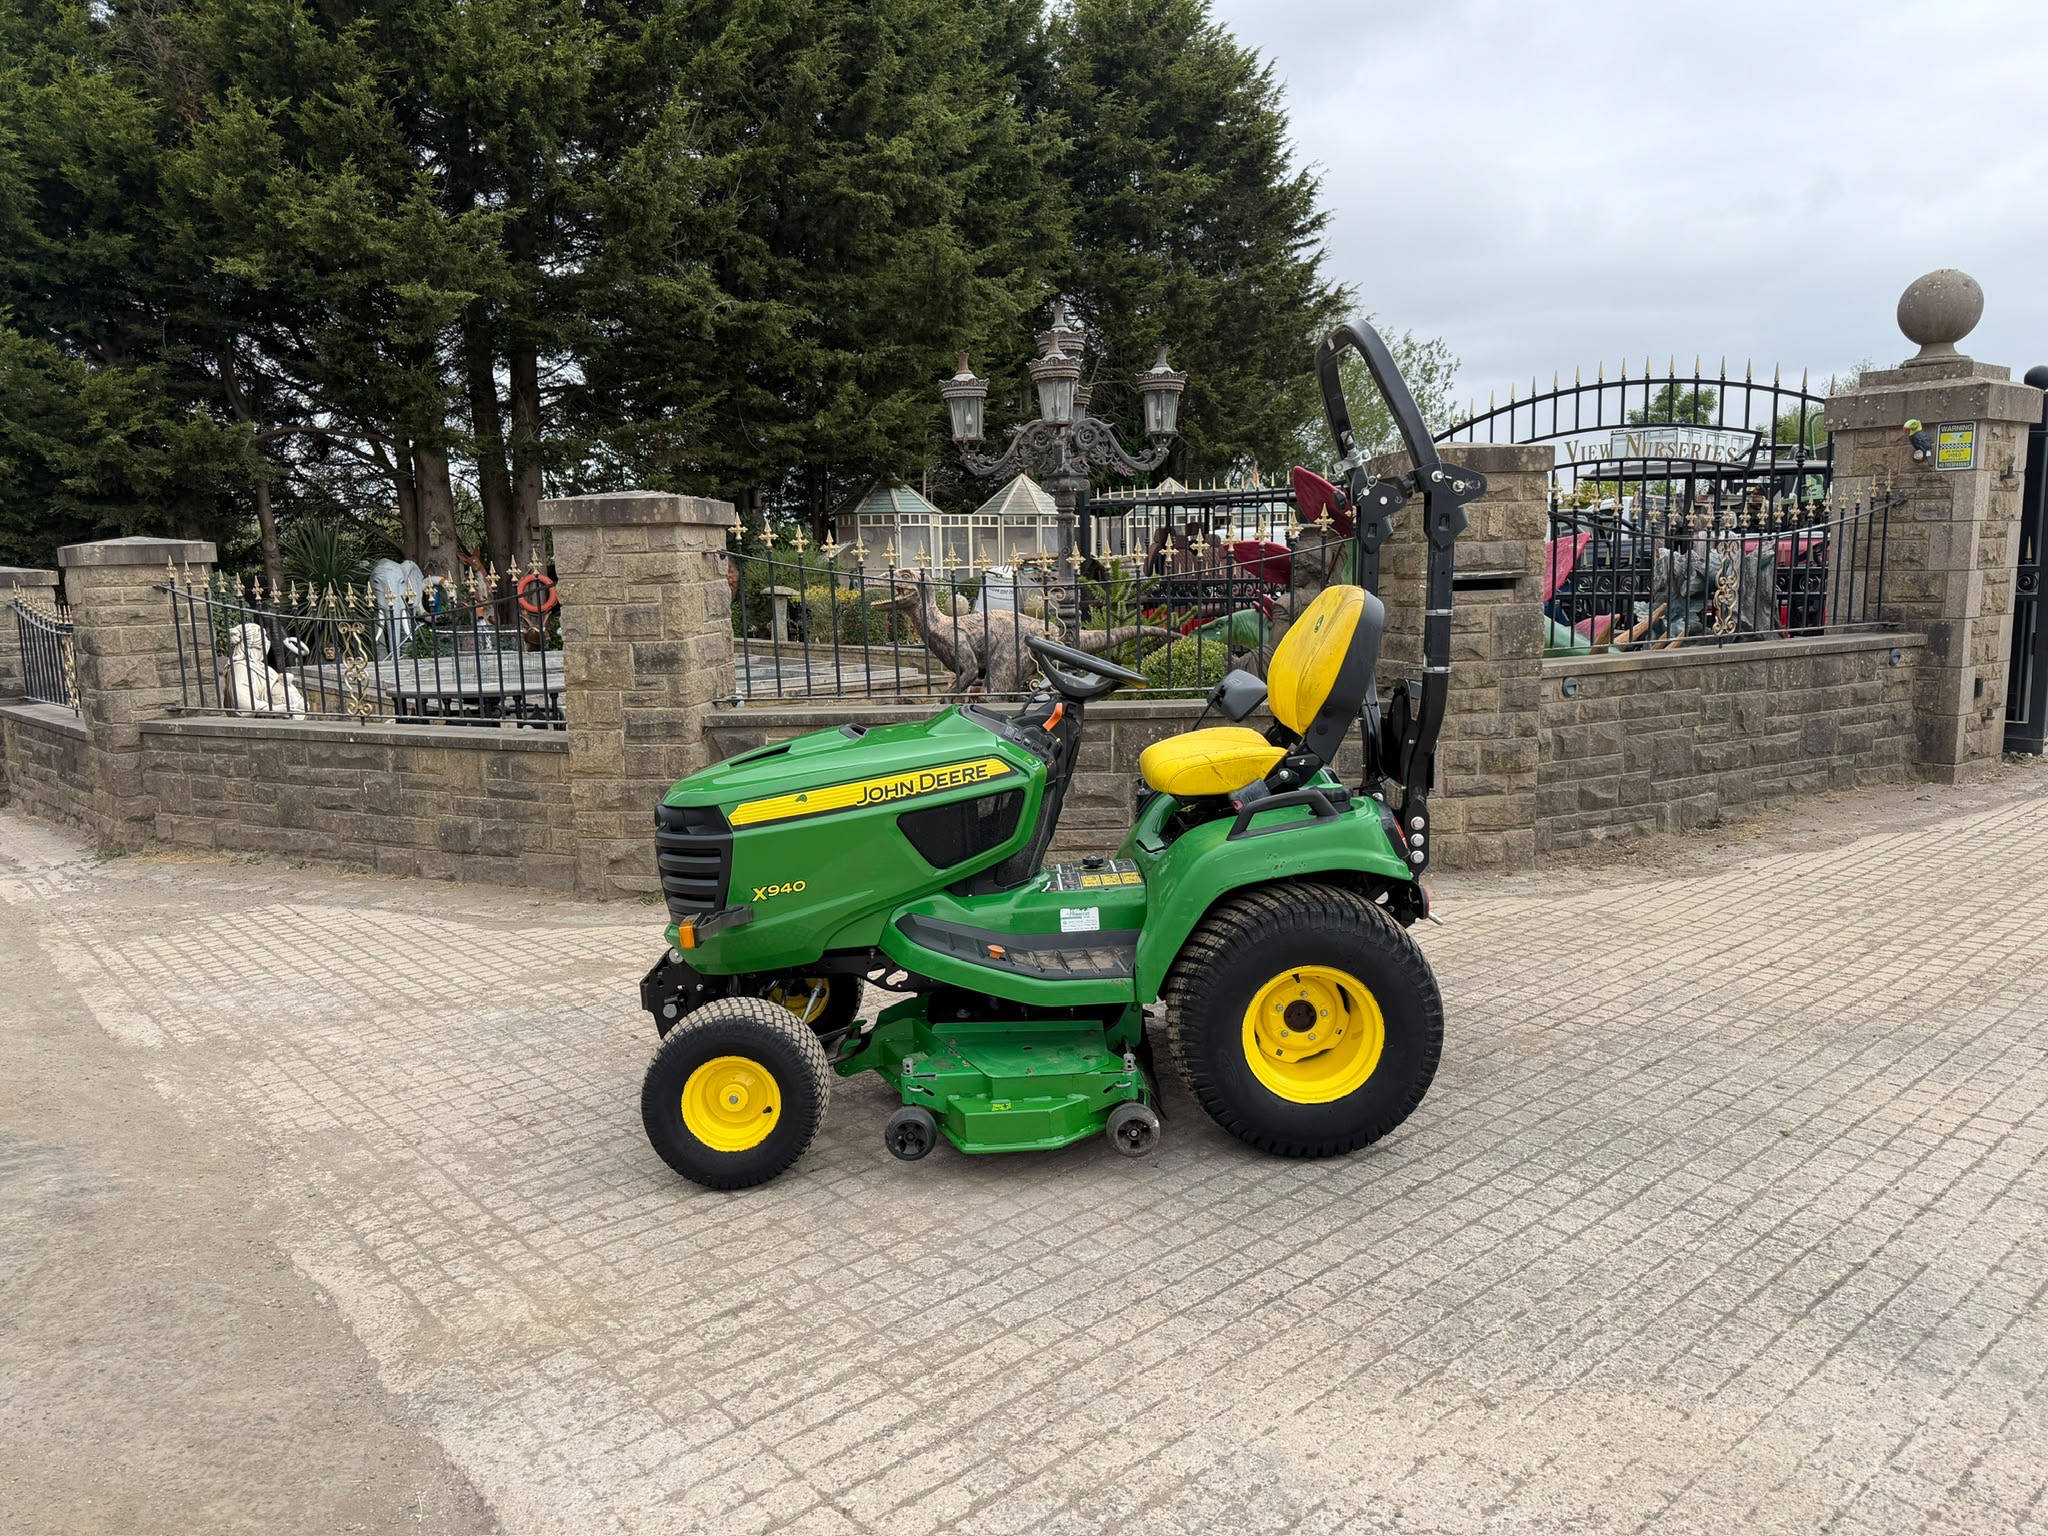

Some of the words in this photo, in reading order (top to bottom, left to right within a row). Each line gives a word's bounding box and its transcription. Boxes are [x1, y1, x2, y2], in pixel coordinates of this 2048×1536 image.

[1941, 424, 1973, 432] WARNING
[1625, 431, 1737, 464] NURSERIES
[856, 779, 914, 804] JOHN
[919, 764, 988, 790] DEERE
[752, 880, 806, 902] X940
